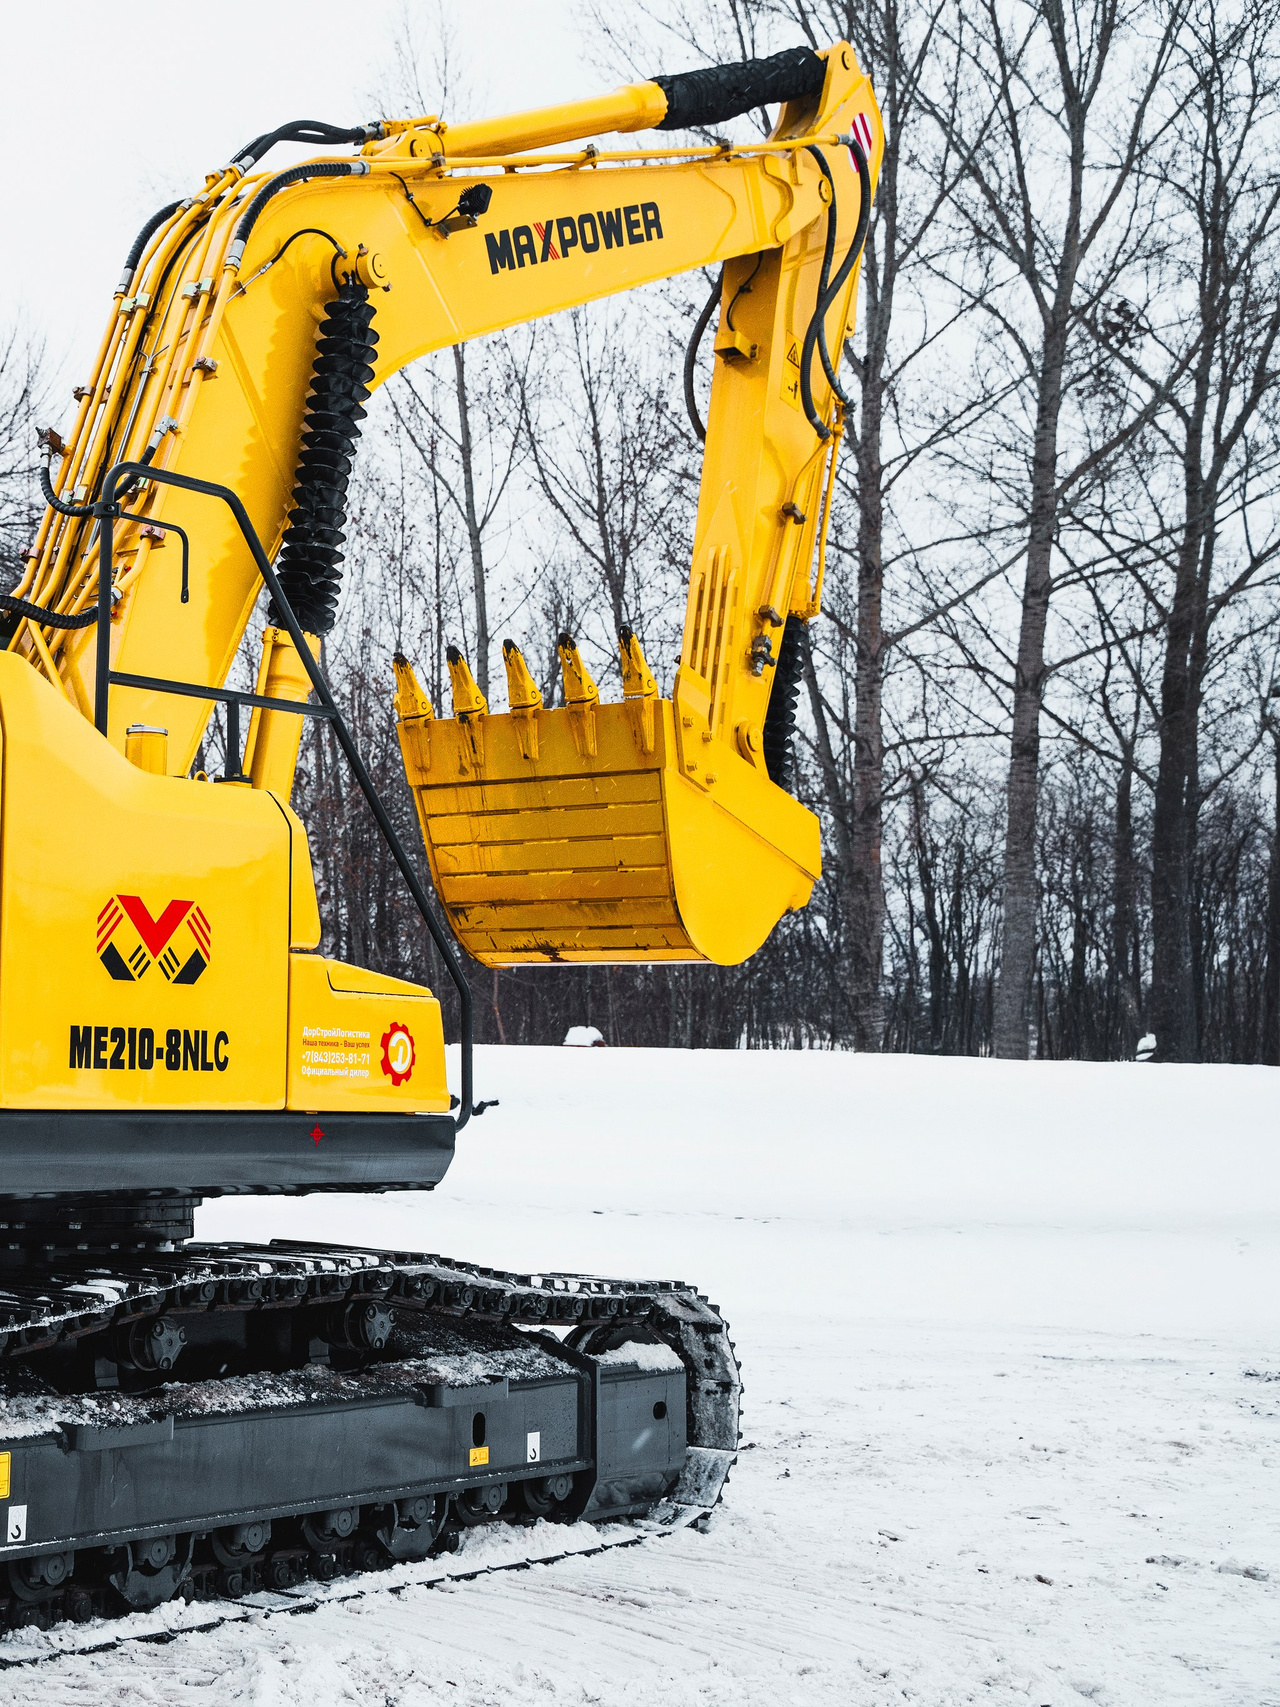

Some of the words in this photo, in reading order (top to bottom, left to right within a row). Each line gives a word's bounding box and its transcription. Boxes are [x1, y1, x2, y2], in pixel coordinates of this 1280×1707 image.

[484, 201, 664, 275] MAXPOWER
[302, 1026, 370, 1038] ДорСтройЛогистика
[69, 1025, 230, 1072] ME210-8NLC
[318, 1040, 339, 1048] техника
[343, 1040, 356, 1048] Ваш
[302, 1050, 370, 1064] +7(843)253-81-71
[301, 1066, 348, 1077] Официальный
[349, 1069, 370, 1079] дилер
